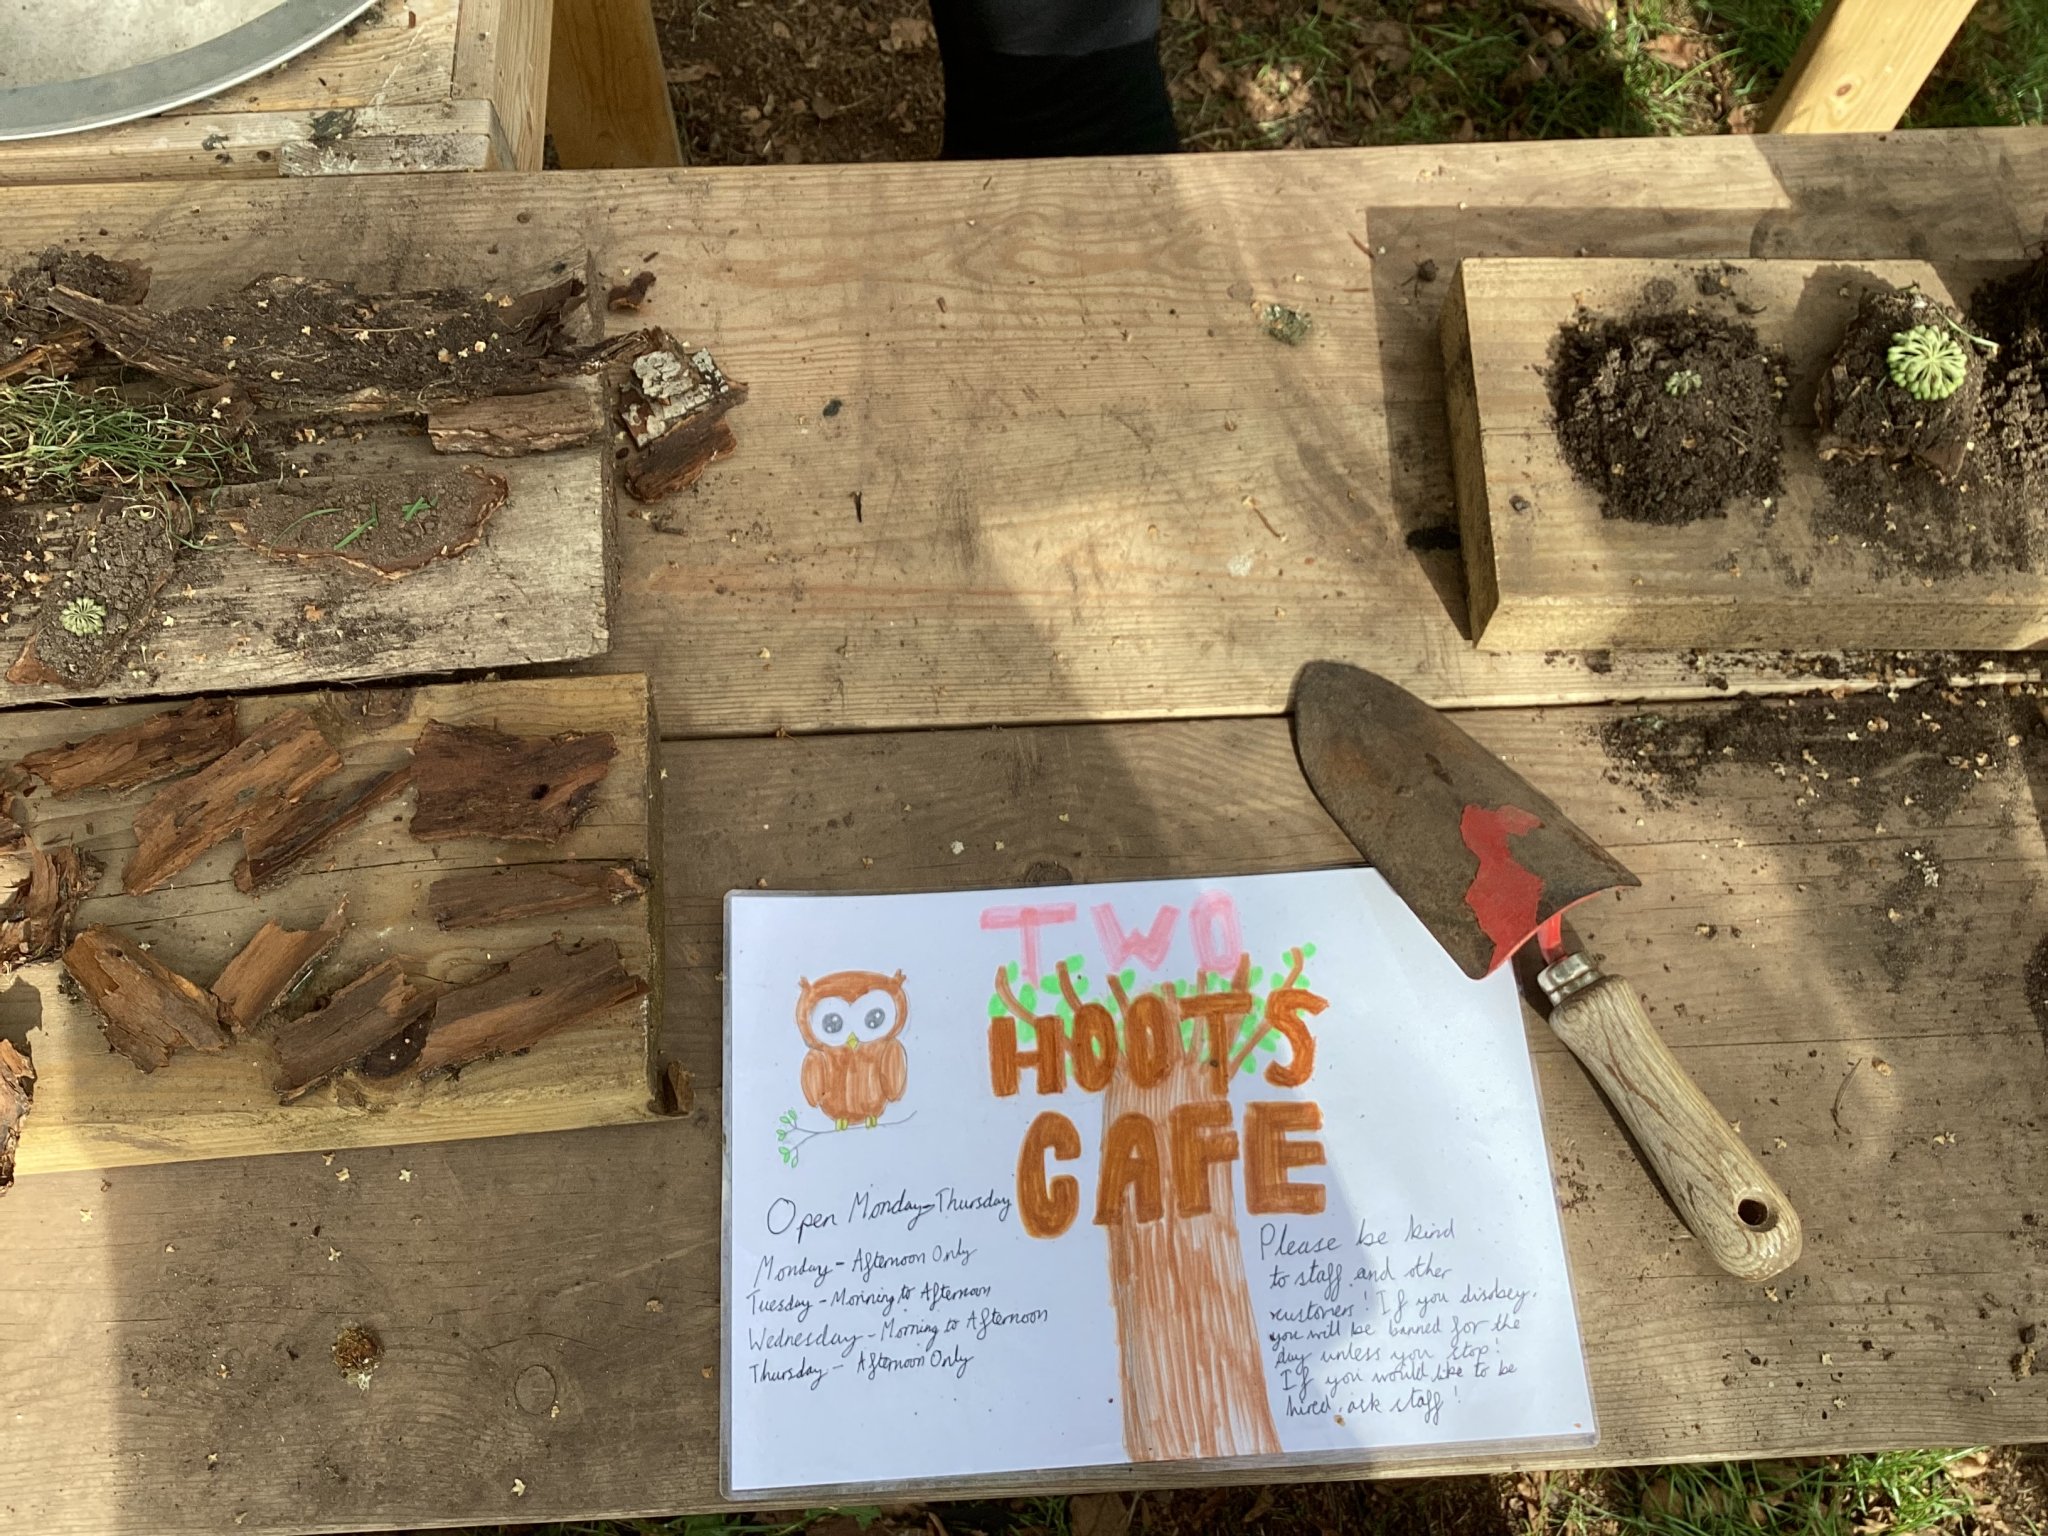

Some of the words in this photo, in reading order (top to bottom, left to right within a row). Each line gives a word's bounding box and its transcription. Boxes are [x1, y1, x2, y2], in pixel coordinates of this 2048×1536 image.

[980, 889, 1244, 988] TWO
[988, 988, 1329, 1097] HOOTS
[1016, 1100, 1326, 1239] CAFE
[766, 1198, 837, 1244] Open
[1260, 1223, 1343, 1261] Please
[1356, 1217, 1390, 1247] be
[1404, 1214, 1456, 1243] kind
[753, 1255, 834, 1287] Monday
[851, 1247, 926, 1283] Afternoon
[932, 1237, 979, 1266] Only
[1269, 1264, 1291, 1290] to
[1353, 1256, 1396, 1283] and
[1403, 1252, 1453, 1279] other
[746, 1288, 814, 1323] Tuesday
[896, 1284, 916, 1304] to
[1375, 1288, 1409, 1325] If
[1415, 1293, 1450, 1320] you
[748, 1323, 863, 1359] Wednesday
[880, 1317, 939, 1352] Morning
[942, 1318, 960, 1332] to
[966, 1307, 1049, 1341] Afternoon
[1268, 1329, 1304, 1352] you
[1306, 1320, 1342, 1342] will
[1350, 1322, 1376, 1337] be
[1388, 1317, 1443, 1338] banned
[1450, 1315, 1490, 1349] for
[1490, 1313, 1521, 1333] the
[748, 1356, 829, 1392] Thursday
[856, 1350, 925, 1381] Afternoon
[930, 1344, 975, 1378] Only
[1274, 1346, 1313, 1376] day
[1319, 1342, 1381, 1363] unless
[1389, 1349, 1434, 1374] you
[1279, 1366, 1315, 1402] If
[1325, 1370, 1363, 1399] you
[1371, 1360, 1428, 1383] would
[1431, 1360, 1465, 1383] like
[1474, 1361, 1491, 1379] to
[1498, 1359, 1519, 1376] be
[1347, 1392, 1384, 1414] ask
